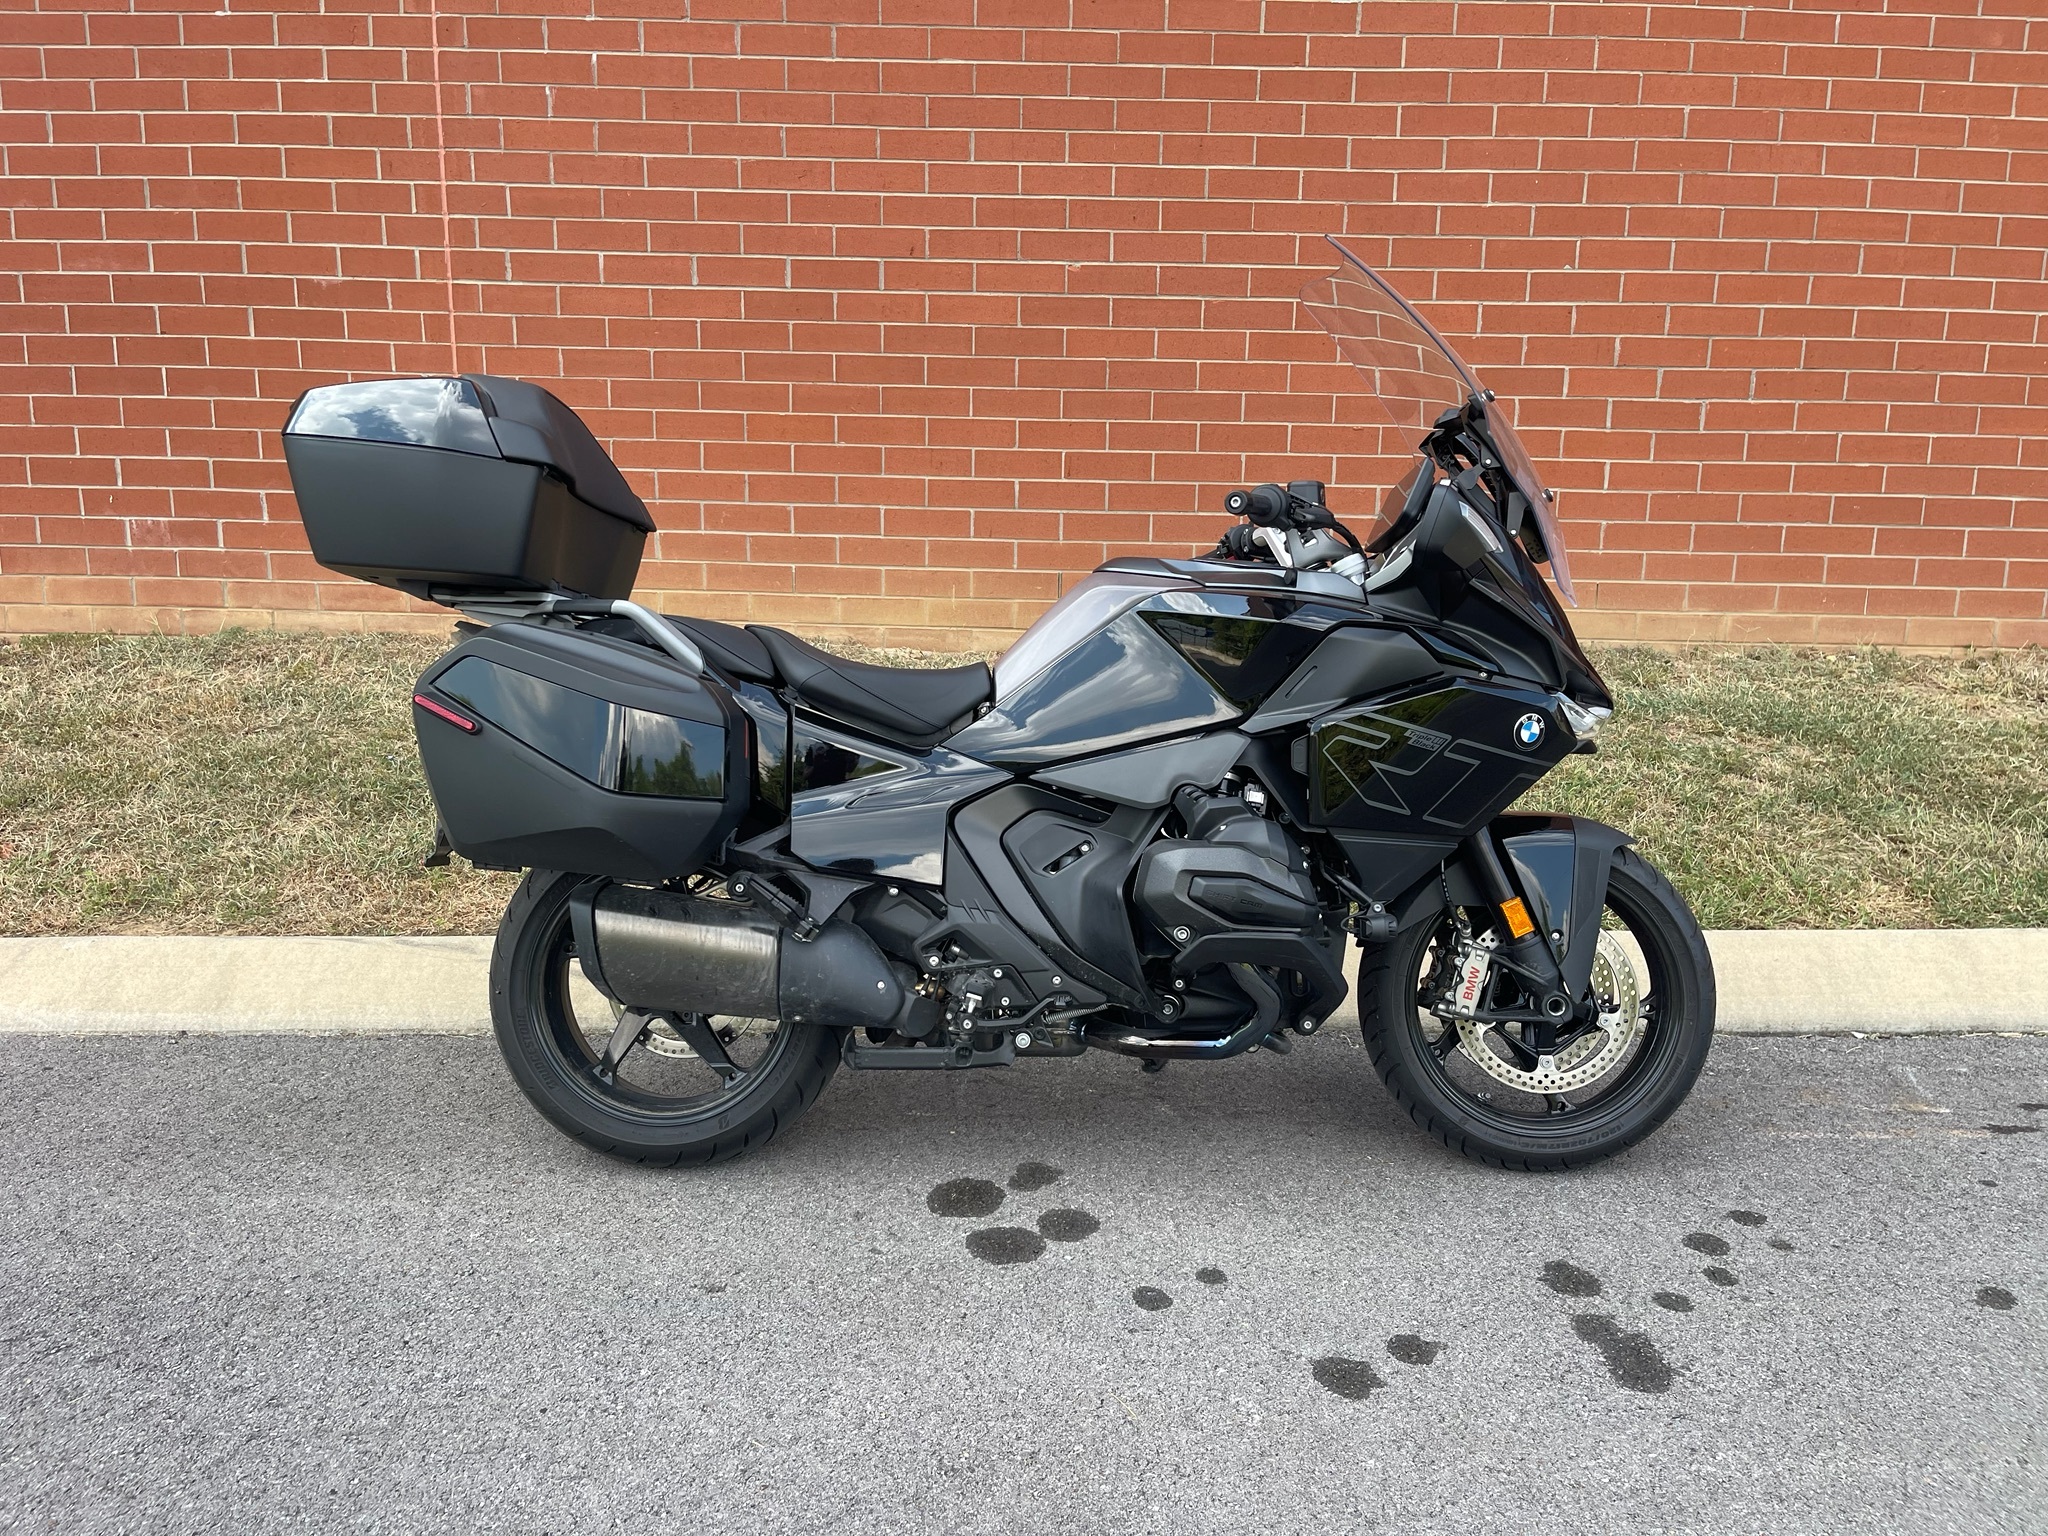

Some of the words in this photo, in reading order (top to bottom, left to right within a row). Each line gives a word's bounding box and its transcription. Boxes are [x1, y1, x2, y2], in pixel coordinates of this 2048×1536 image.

[1409, 731, 1433, 741] Triple
[1412, 739, 1436, 750] Black
[1462, 965, 1481, 1001] BMW
